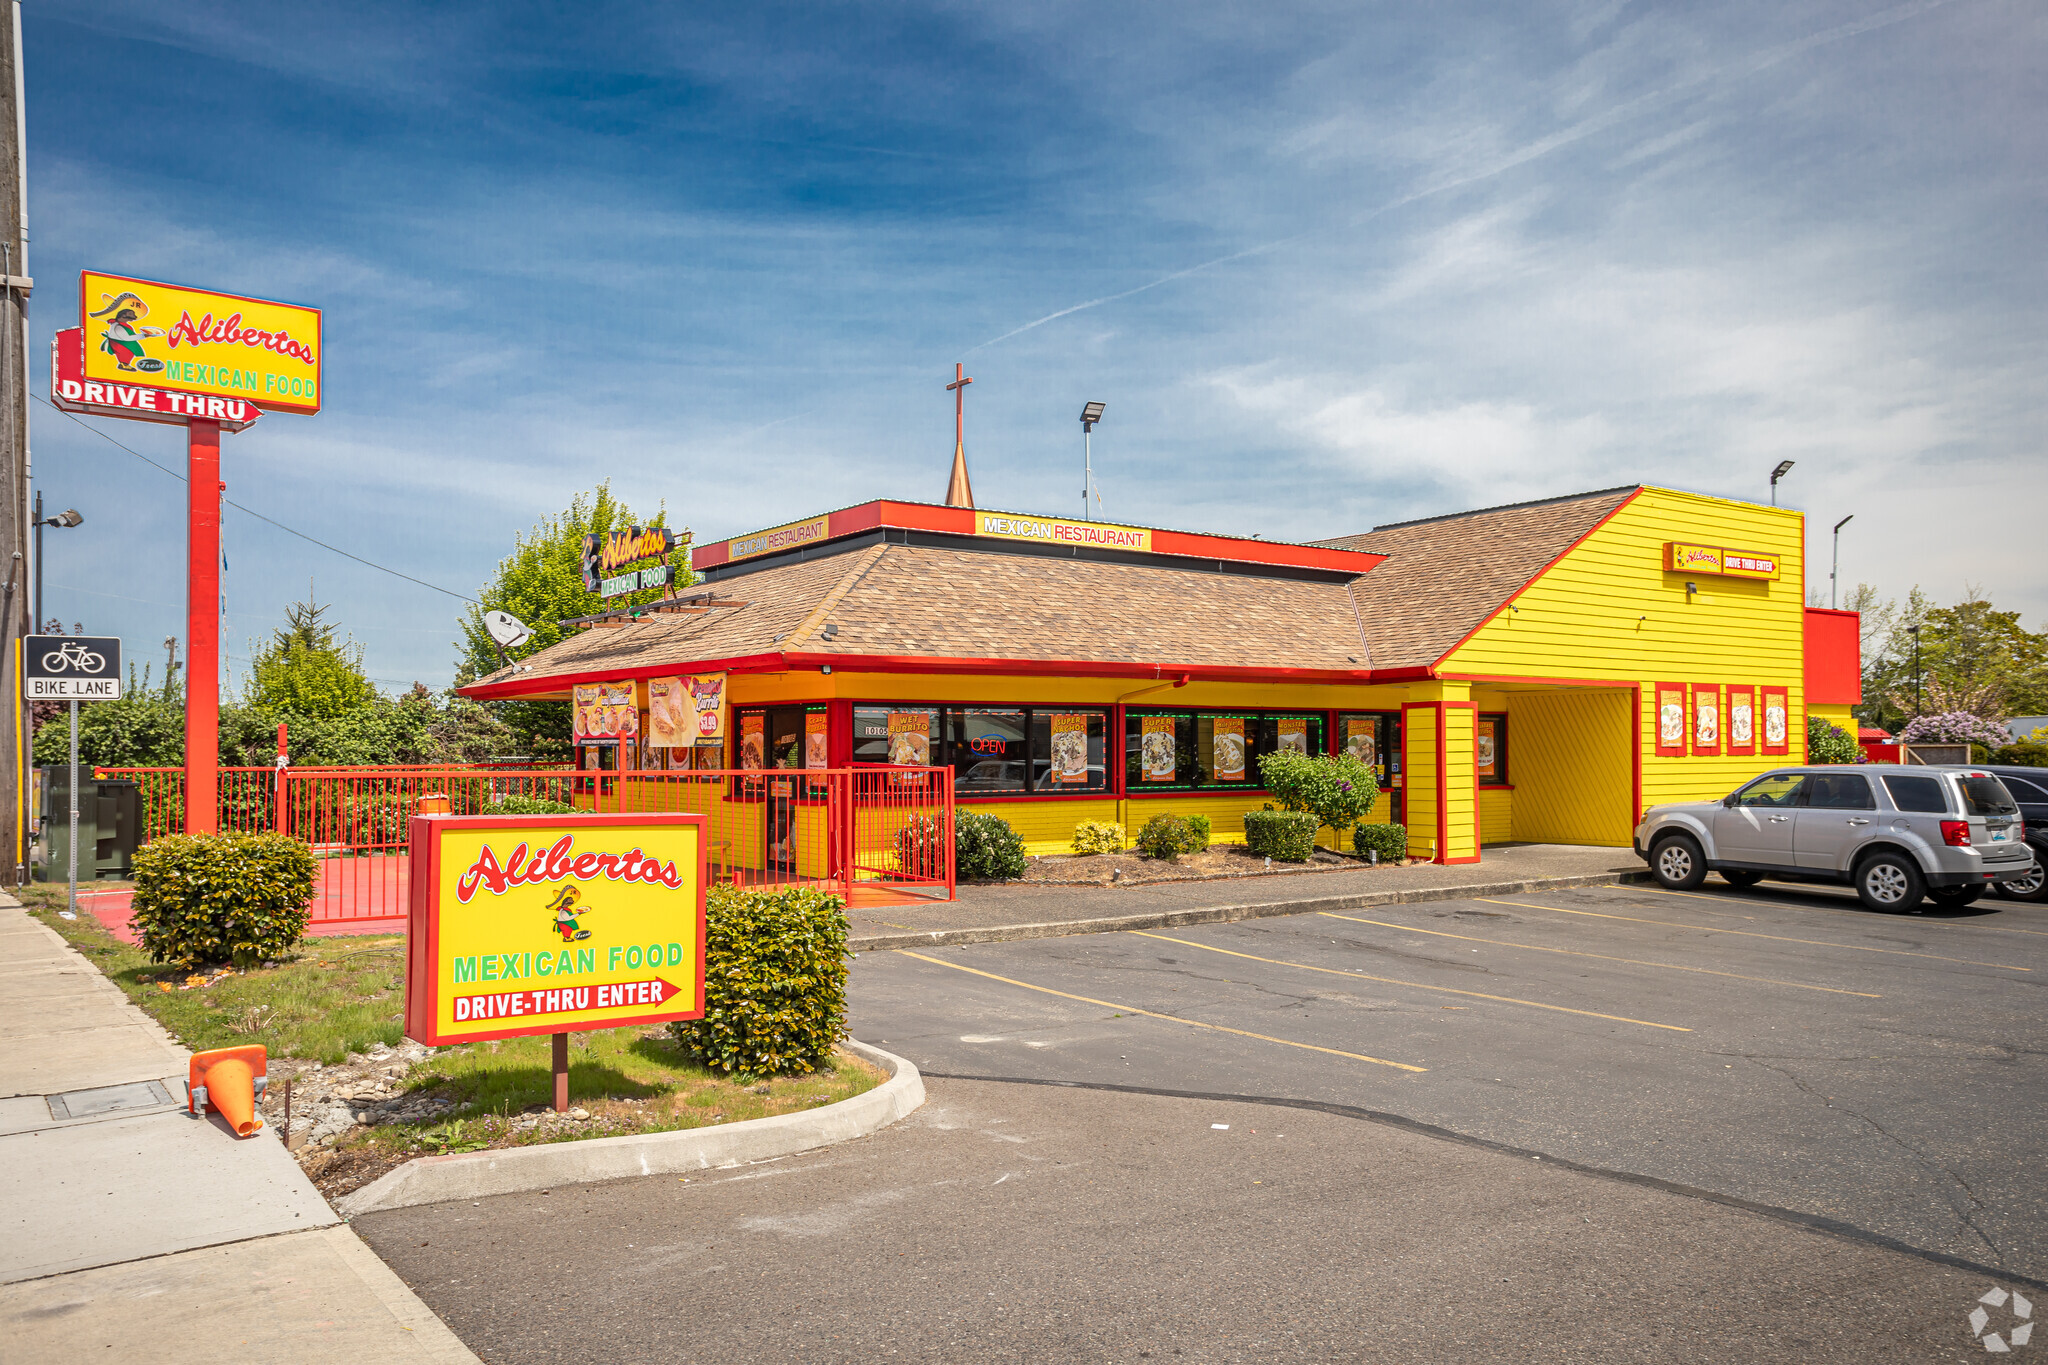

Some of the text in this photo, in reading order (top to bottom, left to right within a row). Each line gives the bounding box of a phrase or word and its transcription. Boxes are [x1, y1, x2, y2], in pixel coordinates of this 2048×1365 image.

[130, 301, 141, 309] JR
[167, 309, 315, 366] Alibertos
[166, 360, 316, 399] MEXICAN FOOD
[62, 380, 246, 420] DRIVE THRU
[732, 521, 824, 557] MEXICAN RESTAURANT
[984, 517, 1144, 547] MEXICAN RESTAURANT
[602, 526, 667, 570] Alibertos
[1725, 556, 1773, 572] DRIVE THRU ENTER
[601, 565, 667, 598] MEXICAN FOOD
[35, 681, 113, 695] BIKE LANE
[700, 715, 717, 731] $3.99
[900, 715, 919, 724] WET
[1057, 717, 1081, 726] SUPER
[1144, 718, 1172, 726] SUPER
[890, 723, 928, 733] BURRITO
[1053, 724, 1085, 733] NACHOS
[1145, 725, 1170, 733] FRIES
[971, 738, 1005, 753] OPEN
[456, 833, 684, 905] Alibertos
[453, 942, 684, 983] MEXICAN FOOD
[455, 981, 663, 1021] DRIVE-THRU ENTER
